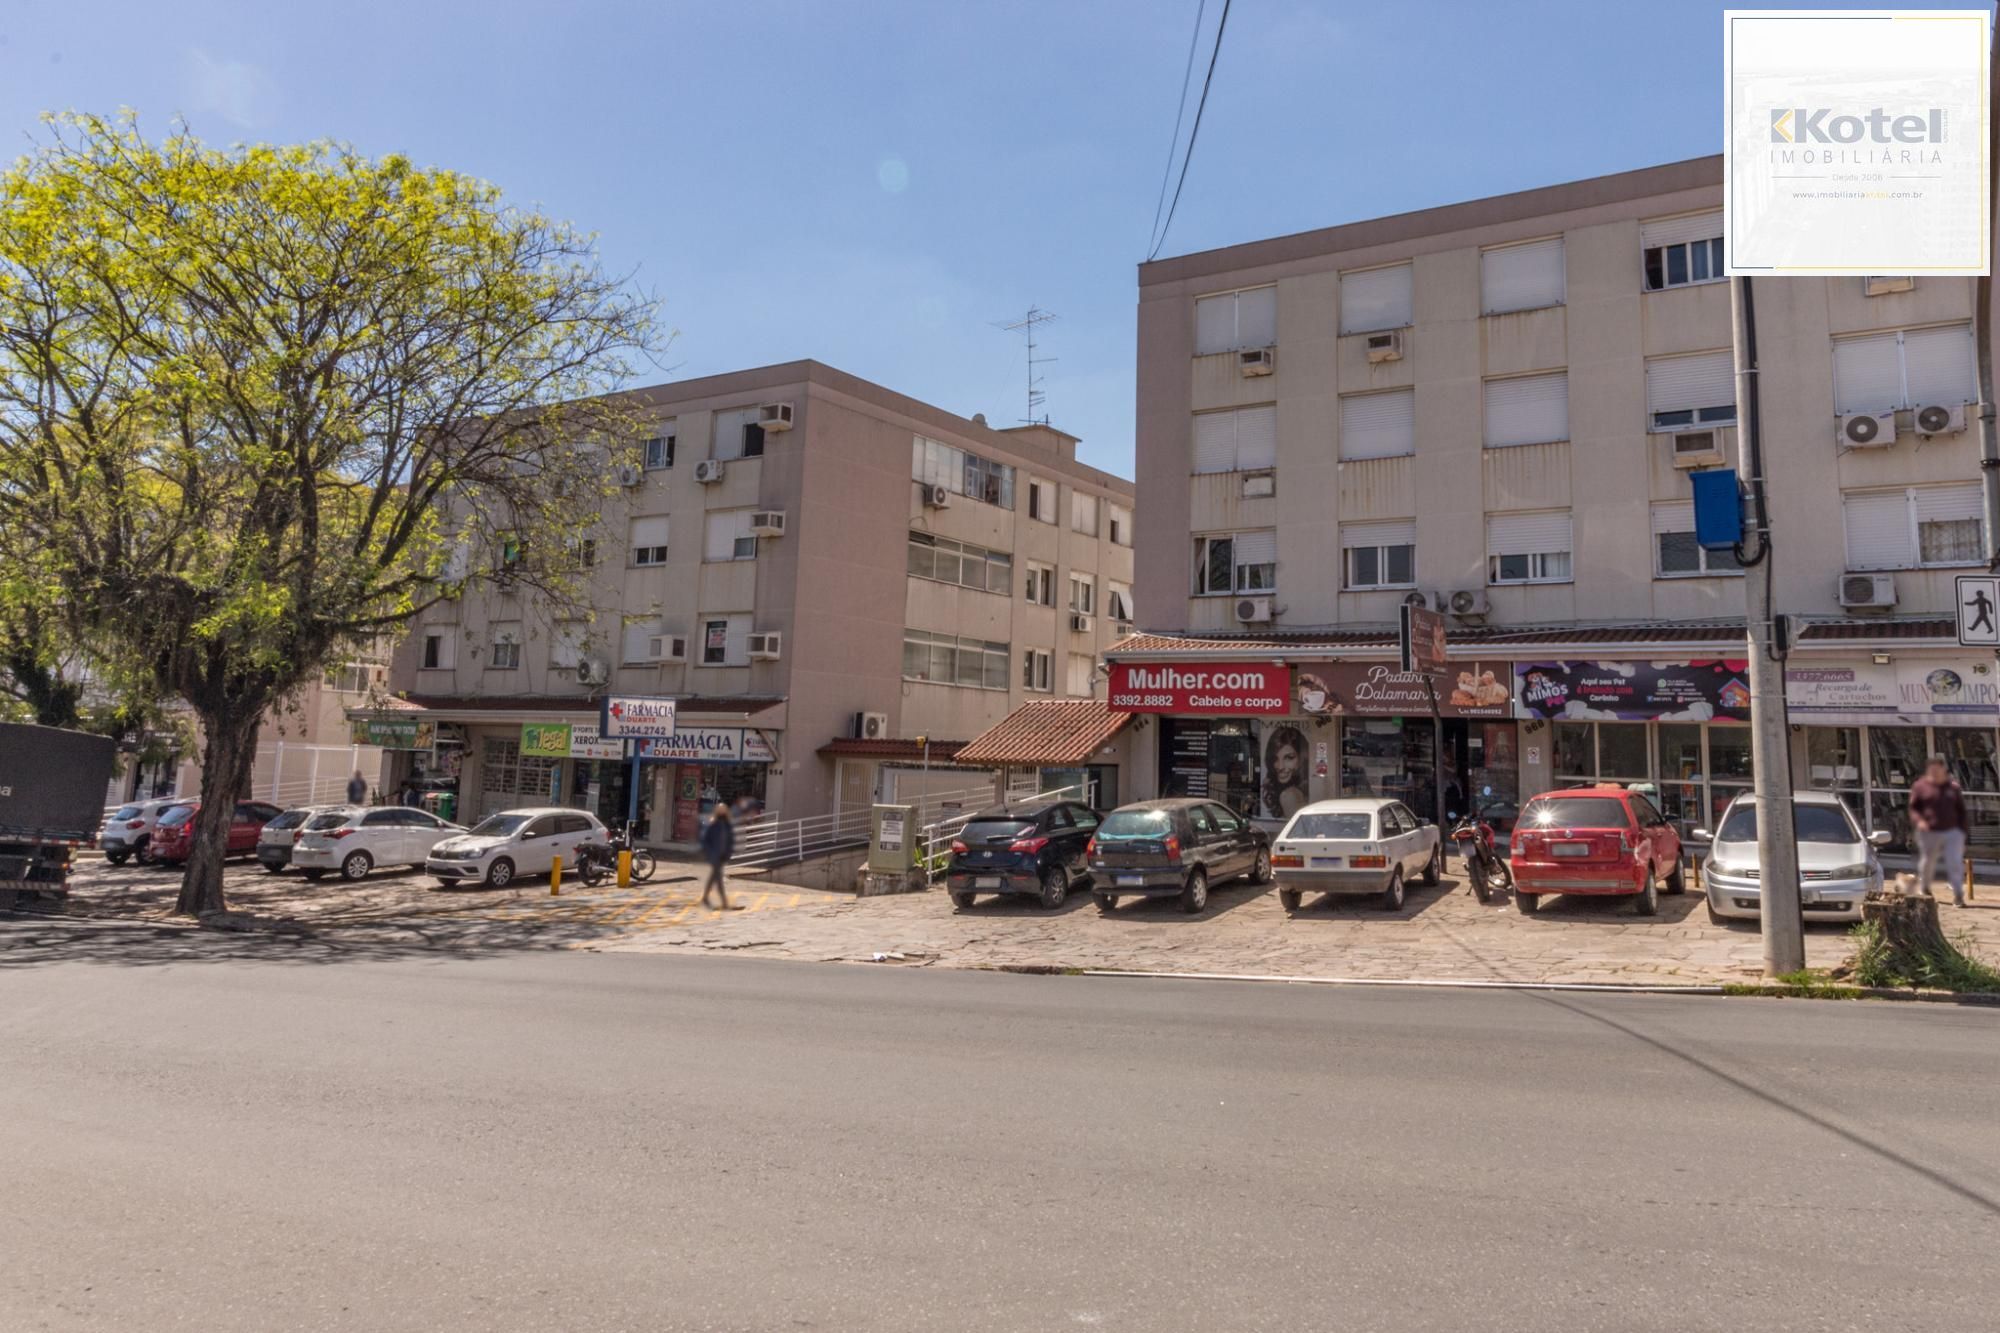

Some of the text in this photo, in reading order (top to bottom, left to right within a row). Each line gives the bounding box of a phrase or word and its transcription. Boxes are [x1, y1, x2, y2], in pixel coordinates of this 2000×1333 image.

[1128, 669, 1265, 690] Mulher.com
[1527, 684, 1568, 702] MIMOS
[1816, 682, 1872, 693] Recarga de
[1113, 695, 1174, 706] 3392.8882
[1829, 692, 1887, 701] Cartuchos
[1189, 696, 1282, 710] Cabelo e corpo
[627, 702, 674, 718] FARMÁCIA
[619, 725, 666, 736] 3344.2742
[574, 736, 599, 745] XEROX
[653, 749, 699, 758] DUARTE
